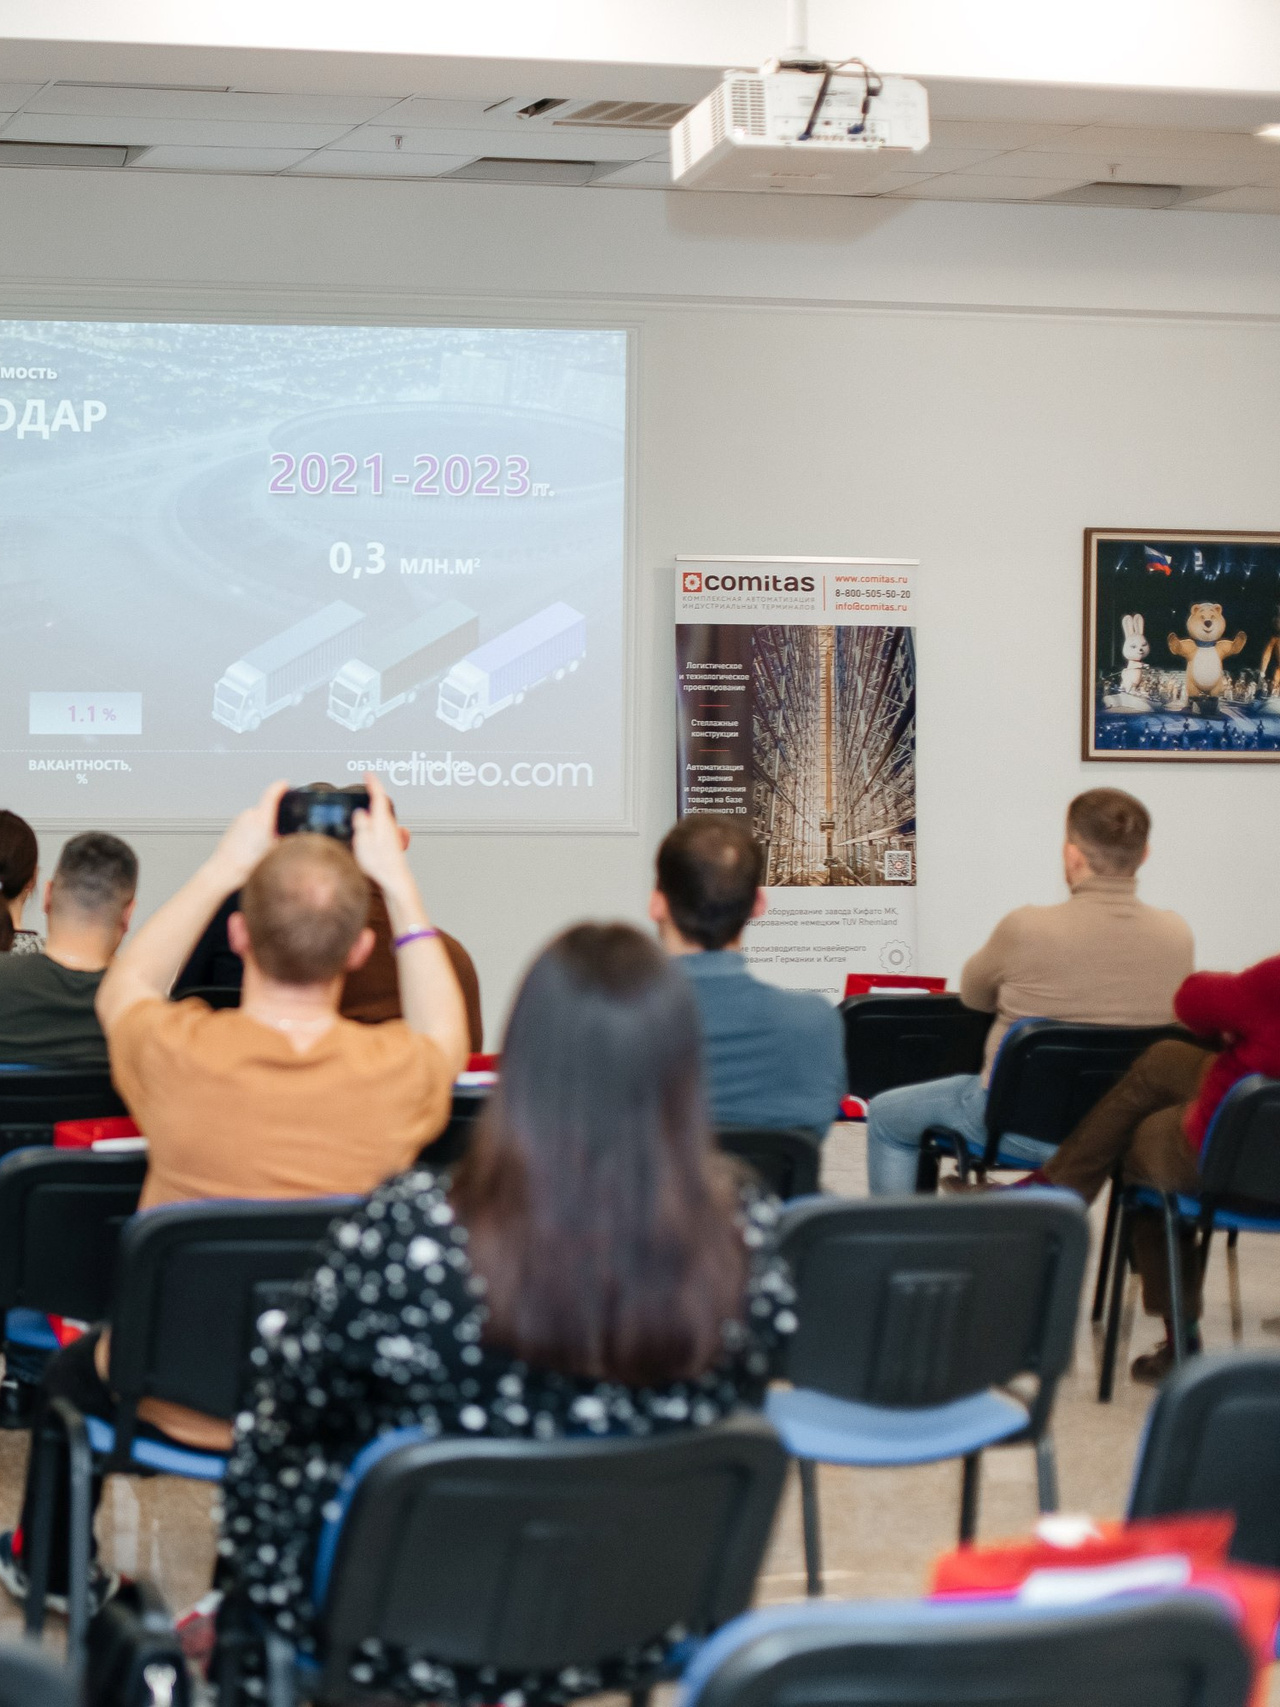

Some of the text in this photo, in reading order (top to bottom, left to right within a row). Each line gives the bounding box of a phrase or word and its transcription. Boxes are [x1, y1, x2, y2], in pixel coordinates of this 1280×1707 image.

[328, 542, 386, 579] 0,3
[704, 575, 815, 592] comitas
[835, 574, 908, 584] www.comitas.ru
[835, 589, 911, 599] 8-800-505-50-20
[835, 602, 908, 612] info@comitas.ru
[686, 662, 743, 670] Логистическое
[67, 705, 117, 722] 1.1 %
[691, 719, 739, 727] Стеллажные
[691, 730, 739, 739] конструкции
[28, 760, 132, 773] ВАКАНТНОСТЬ,
[389, 751, 593, 787] clideo.com
[76, 774, 88, 785] %
[745, 919, 799, 927] ицированное
